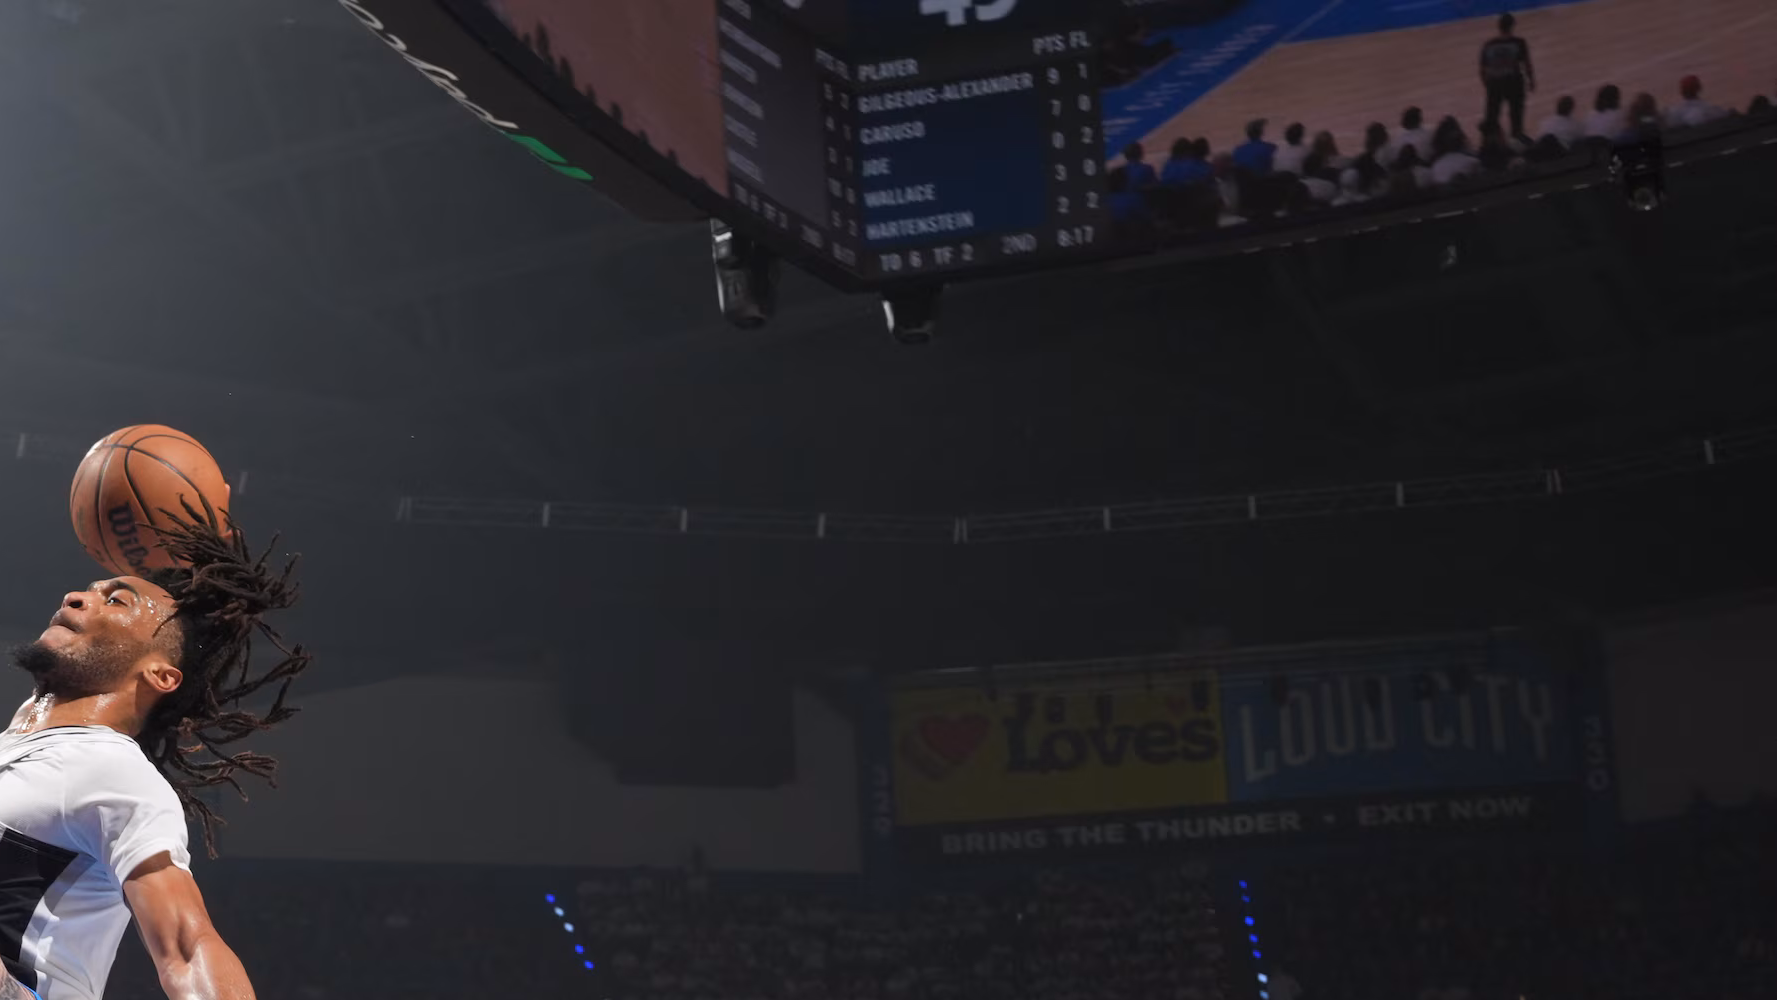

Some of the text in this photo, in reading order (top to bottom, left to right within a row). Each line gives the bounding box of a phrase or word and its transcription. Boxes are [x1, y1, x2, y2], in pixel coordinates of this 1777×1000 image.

[857, 58, 919, 82] PLAYER
[1032, 34, 1065, 54] PTS
[1069, 30, 1091, 48] FL
[857, 62, 1088, 113] GILGEOUS-ALEXANDER 9 1
[860, 120, 925, 144] CARUSO
[862, 157, 891, 177] JOE
[1081, 126, 1094, 144] 2
[864, 183, 935, 208] WALLACE
[1055, 164, 1067, 181] 3
[866, 191, 1099, 240] HARTENSTEIN 2 2
[879, 253, 902, 271] TO
[909, 250, 922, 267] 6
[960, 242, 973, 261] 2
[1001, 233, 1037, 254] 2ND
[1057, 225, 1094, 247] 8:17
[1240, 671, 1552, 783] LOUD CITY
[942, 796, 1532, 854] BRING THE THUNDER EXIT NOW
